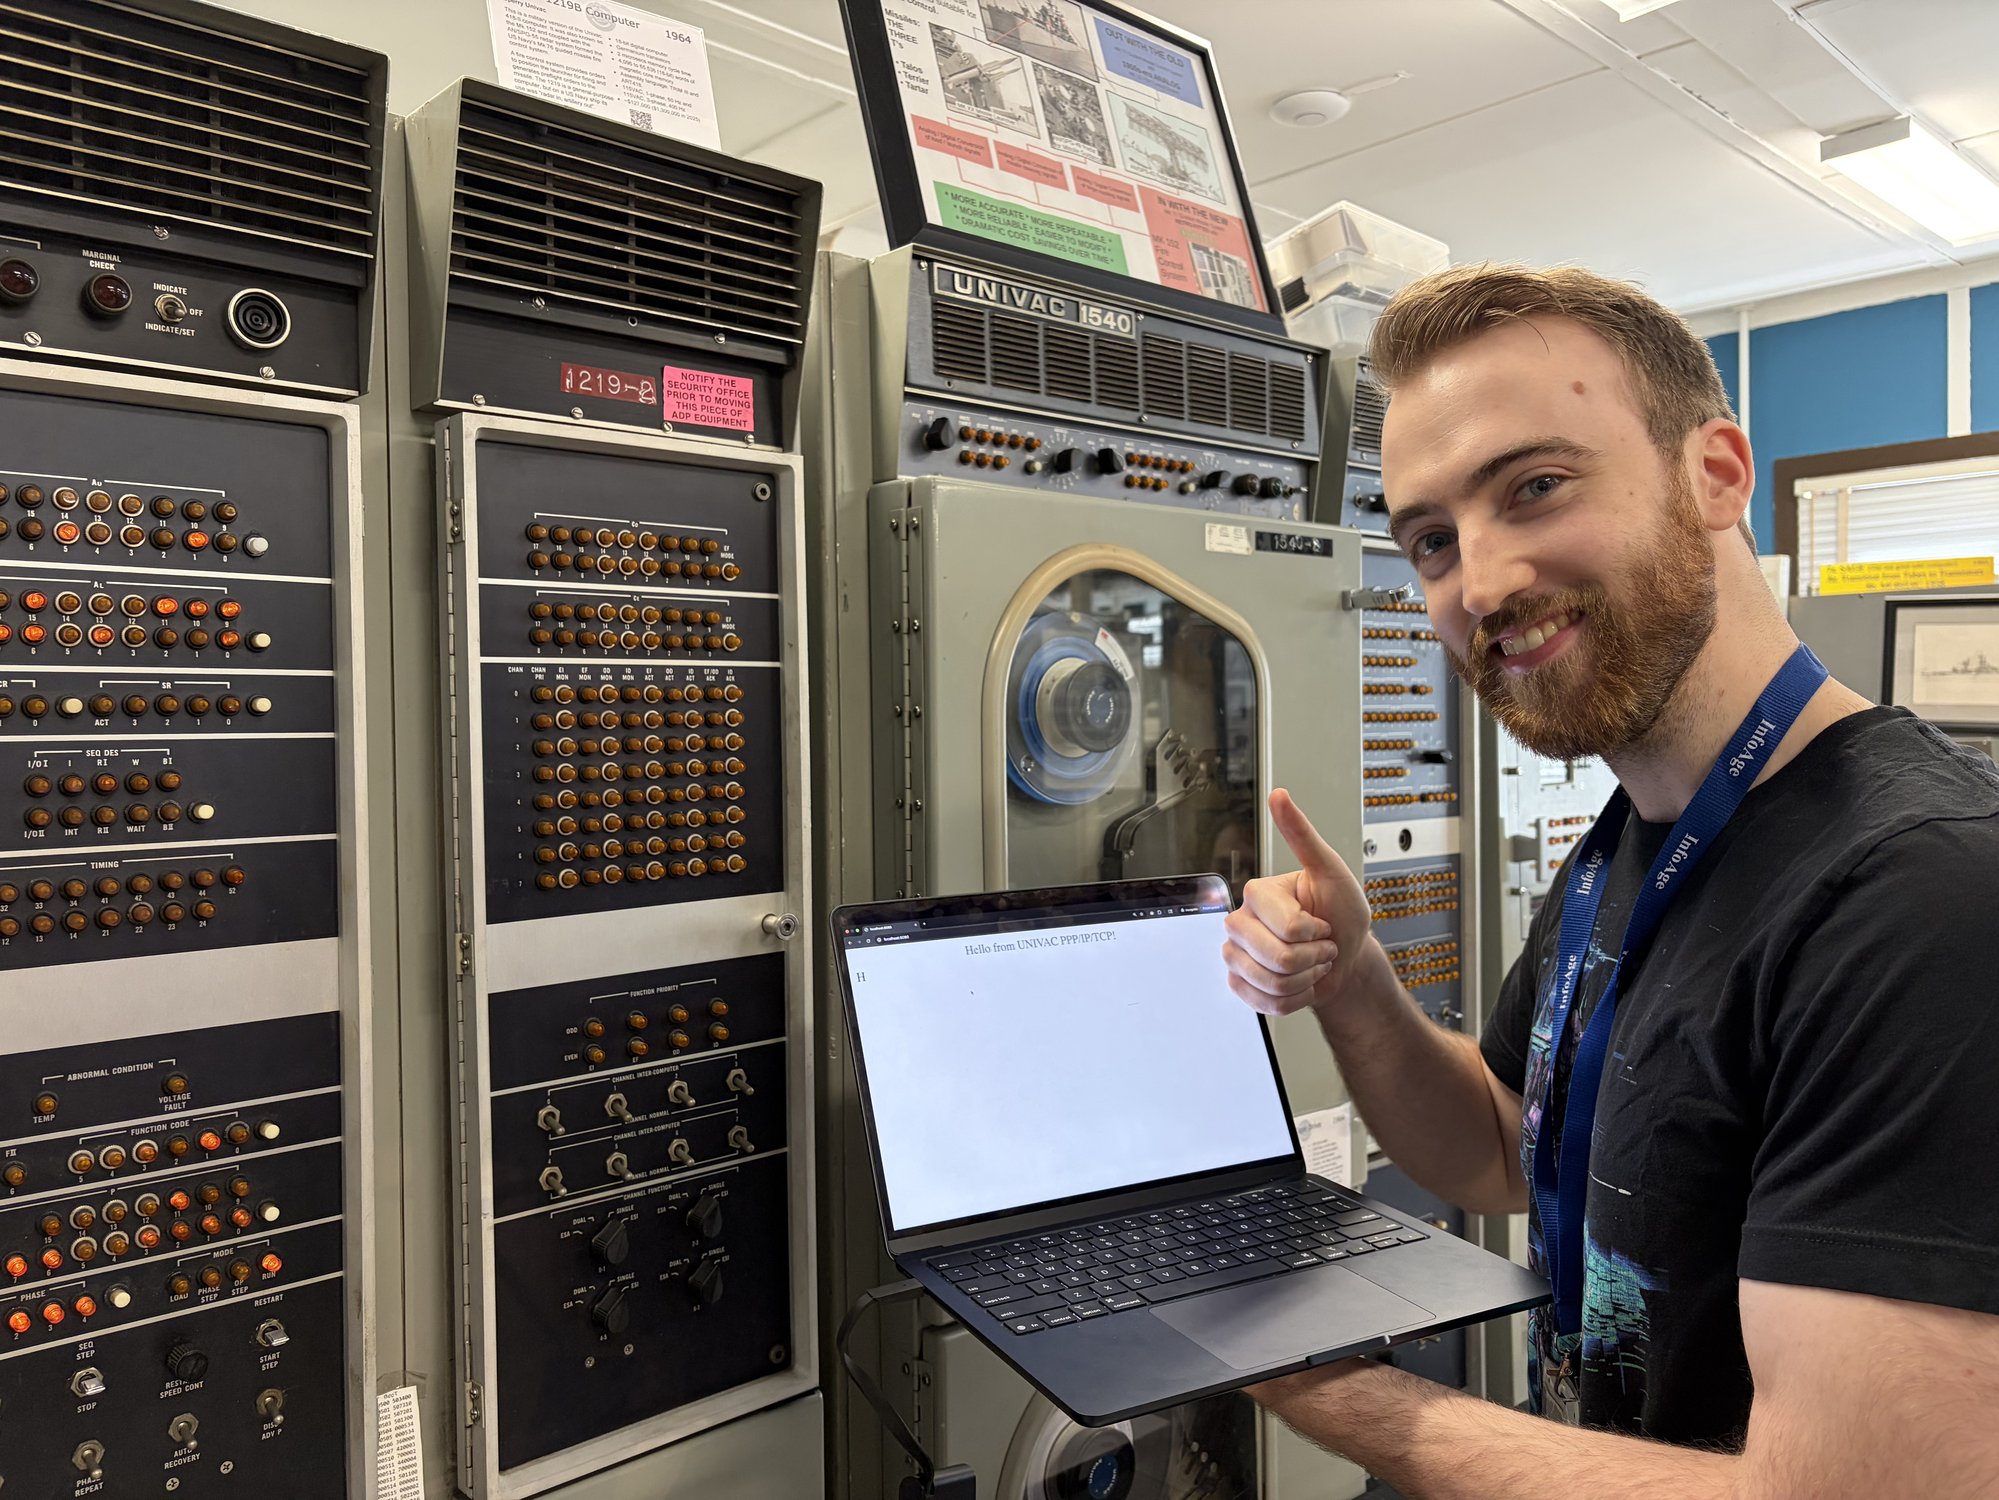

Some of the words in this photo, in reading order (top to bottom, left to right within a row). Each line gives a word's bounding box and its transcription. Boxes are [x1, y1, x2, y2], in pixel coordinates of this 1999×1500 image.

[505, 6, 517, 14] This
[528, 11, 547, 23] military
[548, 19, 567, 29] version
[586, 6, 640, 29] Computer
[885, 8, 920, 27] Missiles:
[967, 8, 977, 19] for
[887, 18, 904, 30] THE
[666, 30, 691, 44] 1964
[889, 28, 918, 44] THREE
[1105, 28, 1123, 40] OUT
[1125, 35, 1147, 51] WITH
[1149, 46, 1166, 60] THE
[1166, 54, 1184, 67] OLD
[566, 65, 588, 75] provides
[900, 60, 923, 73] Talos
[903, 71, 929, 85] Terrier
[905, 81, 928, 94] Tartar
[1157, 196, 1167, 206] IN
[1168, 201, 1190, 212] WITH
[1191, 207, 1208, 219] THE
[1209, 213, 1228, 225] NEW
[951, 192, 977, 207] MORE
[978, 202, 1025, 220] ACCURATE
[1030, 216, 1055, 229] MORE
[1056, 223, 1107, 244] REPEATABLE
[959, 205, 985, 220] MORE
[986, 214, 1029, 231] RELIABLE
[1035, 229, 1066, 243] EASIER
[1066, 235, 1076, 245] TO
[1077, 239, 1107, 253] MODIFY
[961, 217, 1007, 236] DRAMATIC
[1007, 229, 1031, 243] COST
[1032, 237, 1067, 252] SAVINGS
[1068, 246, 1091, 258] OVER
[1092, 253, 1110, 264] TIME
[82, 249, 121, 263] MARGINAL
[90, 260, 116, 270] CHECK
[154, 283, 187, 296] INDICATE
[953, 272, 1066, 318] UNIVAC
[1081, 305, 1131, 333] 1540
[190, 308, 203, 316] OFF
[145, 322, 195, 336] INDICATE/SET
[681, 372, 715, 387] NOTIFY
[719, 378, 736, 387] THE
[668, 381, 713, 393] SECURITY
[717, 387, 749, 399] OFFICE
[667, 392, 697, 402] PRIOR
[715, 397, 751, 408] MOVING
[676, 402, 697, 412] THIS
[702, 405, 727, 415] PIECE
[731, 409, 743, 417] OF
[672, 411, 690, 420] ADP
[695, 413, 748, 428] EQUIPMENT
[1729, 718, 1776, 777] InfoAge
[91, 861, 119, 869] TIMING
[1655, 833, 1699, 890] InfoAge
[1577, 849, 1603, 896] InfoAge
[965, 944, 991, 955] Hello
[993, 943, 1015, 952] from
[1017, 937, 1059, 951] UNIVAC
[1060, 932, 1116, 945] PPP/IP/TCP!
[856, 972, 866, 982] H
[1559, 955, 1577, 1009] InfoAge
[630, 989, 654, 997] FUNCTION
[656, 985, 678, 993] PRIORITY
[68, 1069, 109, 1081] ABNORMAL
[112, 1062, 153, 1074] CONDITION
[612, 1071, 635, 1083] CHANNEL
[637, 1065, 679, 1078] INTER-COMPUTER
[159, 1093, 191, 1104] VOLTAGE
[164, 1101, 186, 1111] FAULT
[33, 1114, 55, 1123] TEMP
[131, 1123, 167, 1135] FUNCTION
[170, 1120, 189, 1129] CODE
[614, 1131, 637, 1140] CHANNEL
[638, 1121, 680, 1135] INTER-COMPUTER
[624, 1190, 646, 1200] CHANNEL
[648, 1183, 672, 1195] FUNCTION
[617, 1205, 634, 1214] SINGLE
[573, 1217, 586, 1225] DUAL
[213, 1247, 233, 1258] MODE
[1293, 1257, 1318, 1266] command
[20, 1289, 46, 1301] PHASE
[232, 1286, 248, 1295] STEP
[170, 1293, 188, 1302] LOAD
[201, 1294, 218, 1303] STEP
[254, 1294, 283, 1307] RESTART
[1113, 1299, 1141, 1308] command
[1082, 1308, 1101, 1316] option
[1050, 1315, 1071, 1324] control
[79, 1341, 94, 1350] SEQ
[76, 1349, 95, 1360] STEP
[260, 1352, 280, 1363] START
[261, 1360, 278, 1371] STEP
[160, 1387, 181, 1398] SPEED
[185, 1381, 204, 1392] CONT
[77, 1402, 96, 1413] STOP
[262, 1431, 275, 1440] ADV
[164, 1453, 200, 1469] RECOVERY
[75, 1482, 103, 1497] REPEAT
